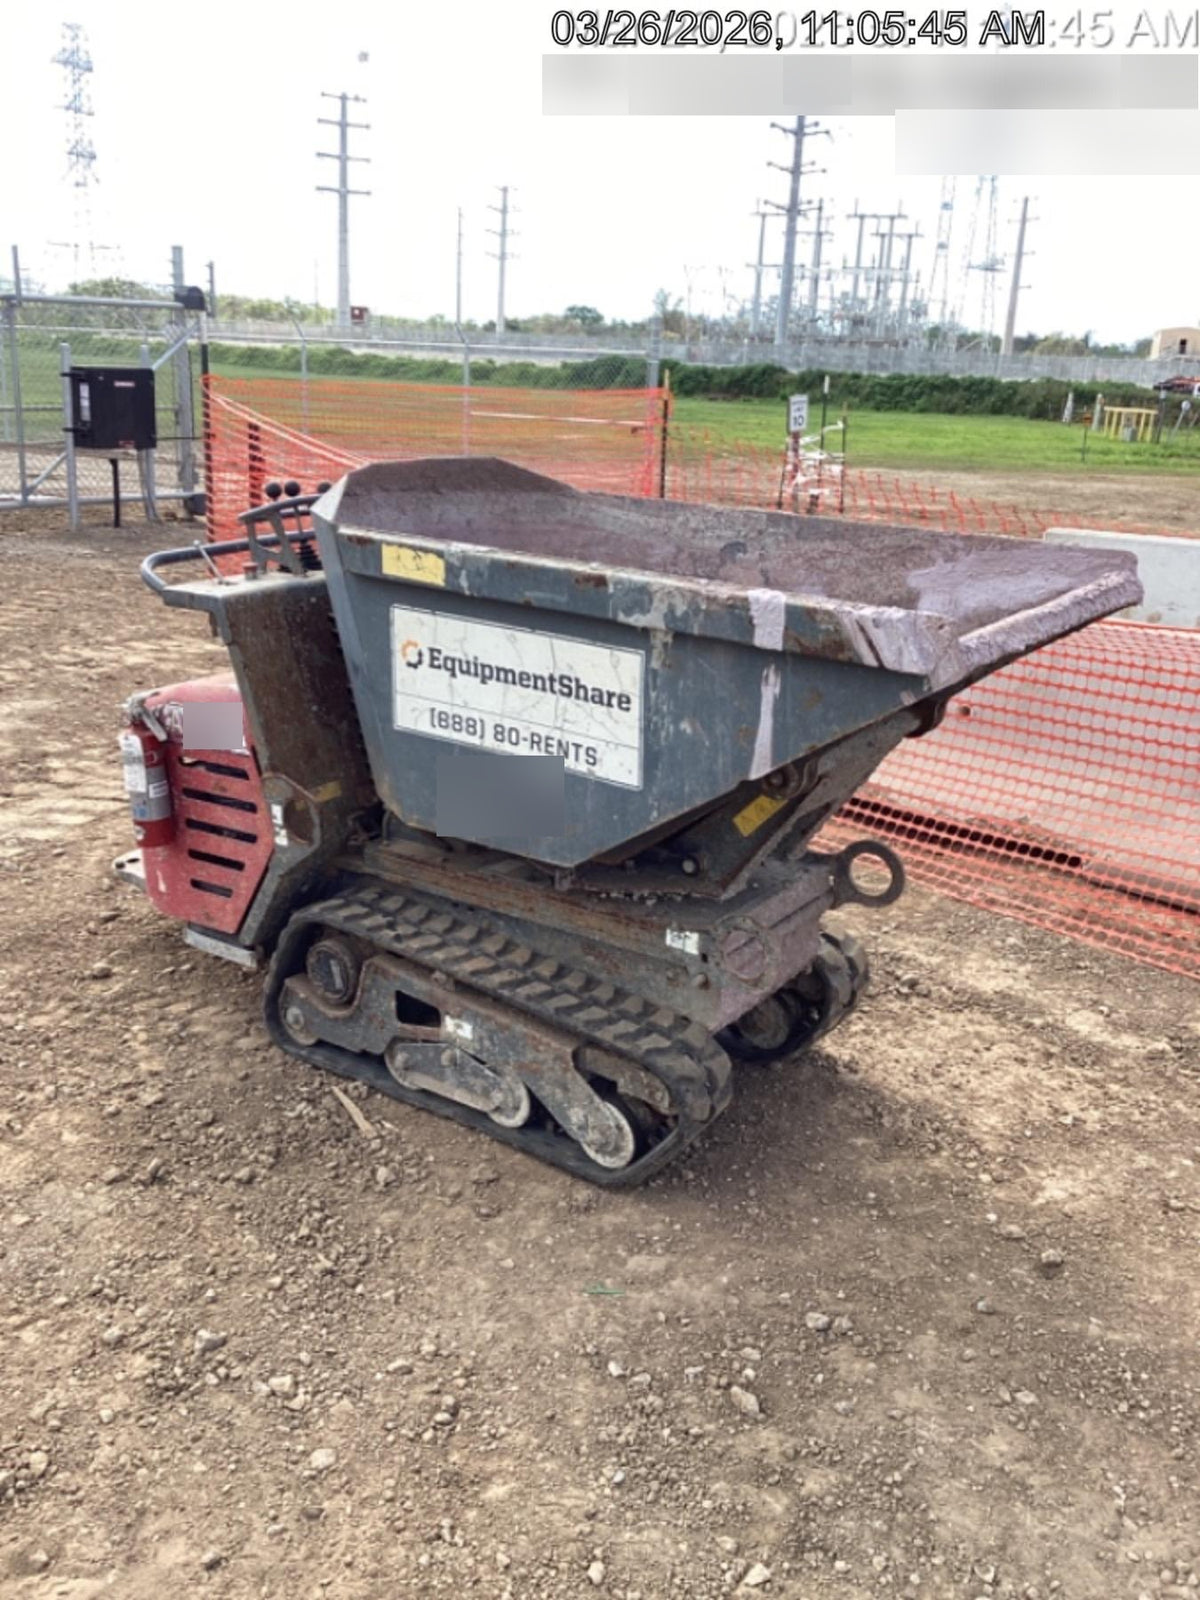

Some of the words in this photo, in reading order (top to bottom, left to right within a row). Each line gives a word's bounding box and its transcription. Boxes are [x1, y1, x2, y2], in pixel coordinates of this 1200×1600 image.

[427, 647, 631, 712] EquipmentShare
[430, 707, 485, 739] (888)
[493, 723, 598, 766] 80-RENTS
